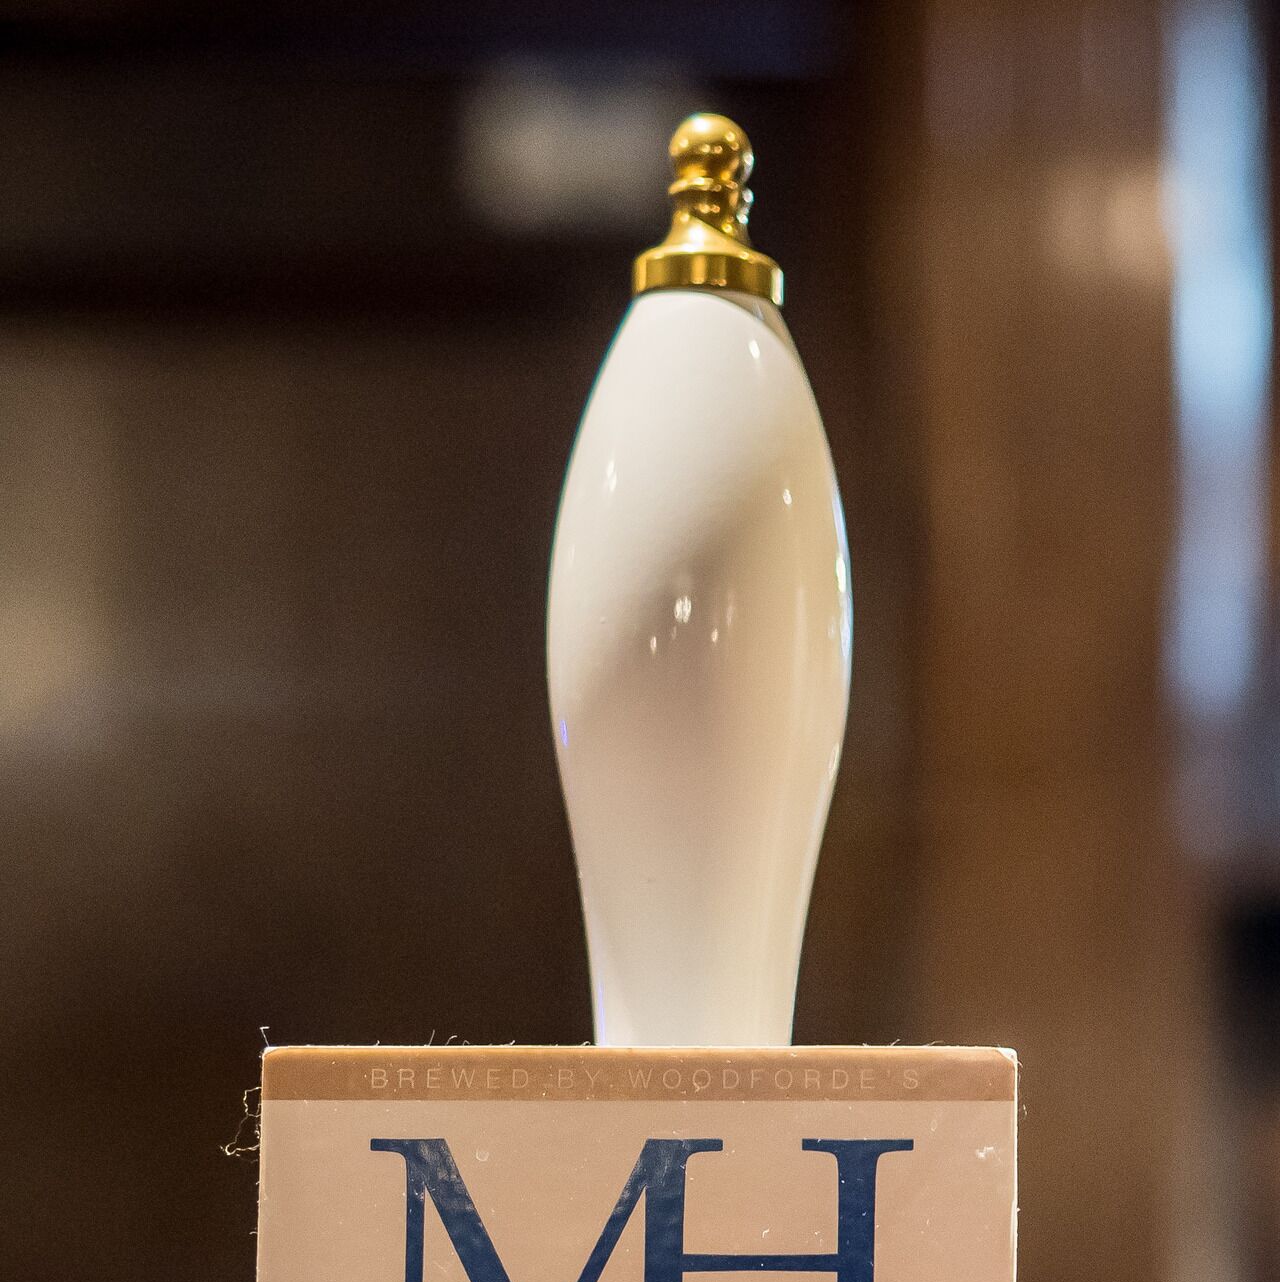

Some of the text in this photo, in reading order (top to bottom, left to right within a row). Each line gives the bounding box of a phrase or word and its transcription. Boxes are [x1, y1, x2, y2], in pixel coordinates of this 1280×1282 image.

[370, 1068, 920, 1090] BREWED BY WOODFORDE'S
